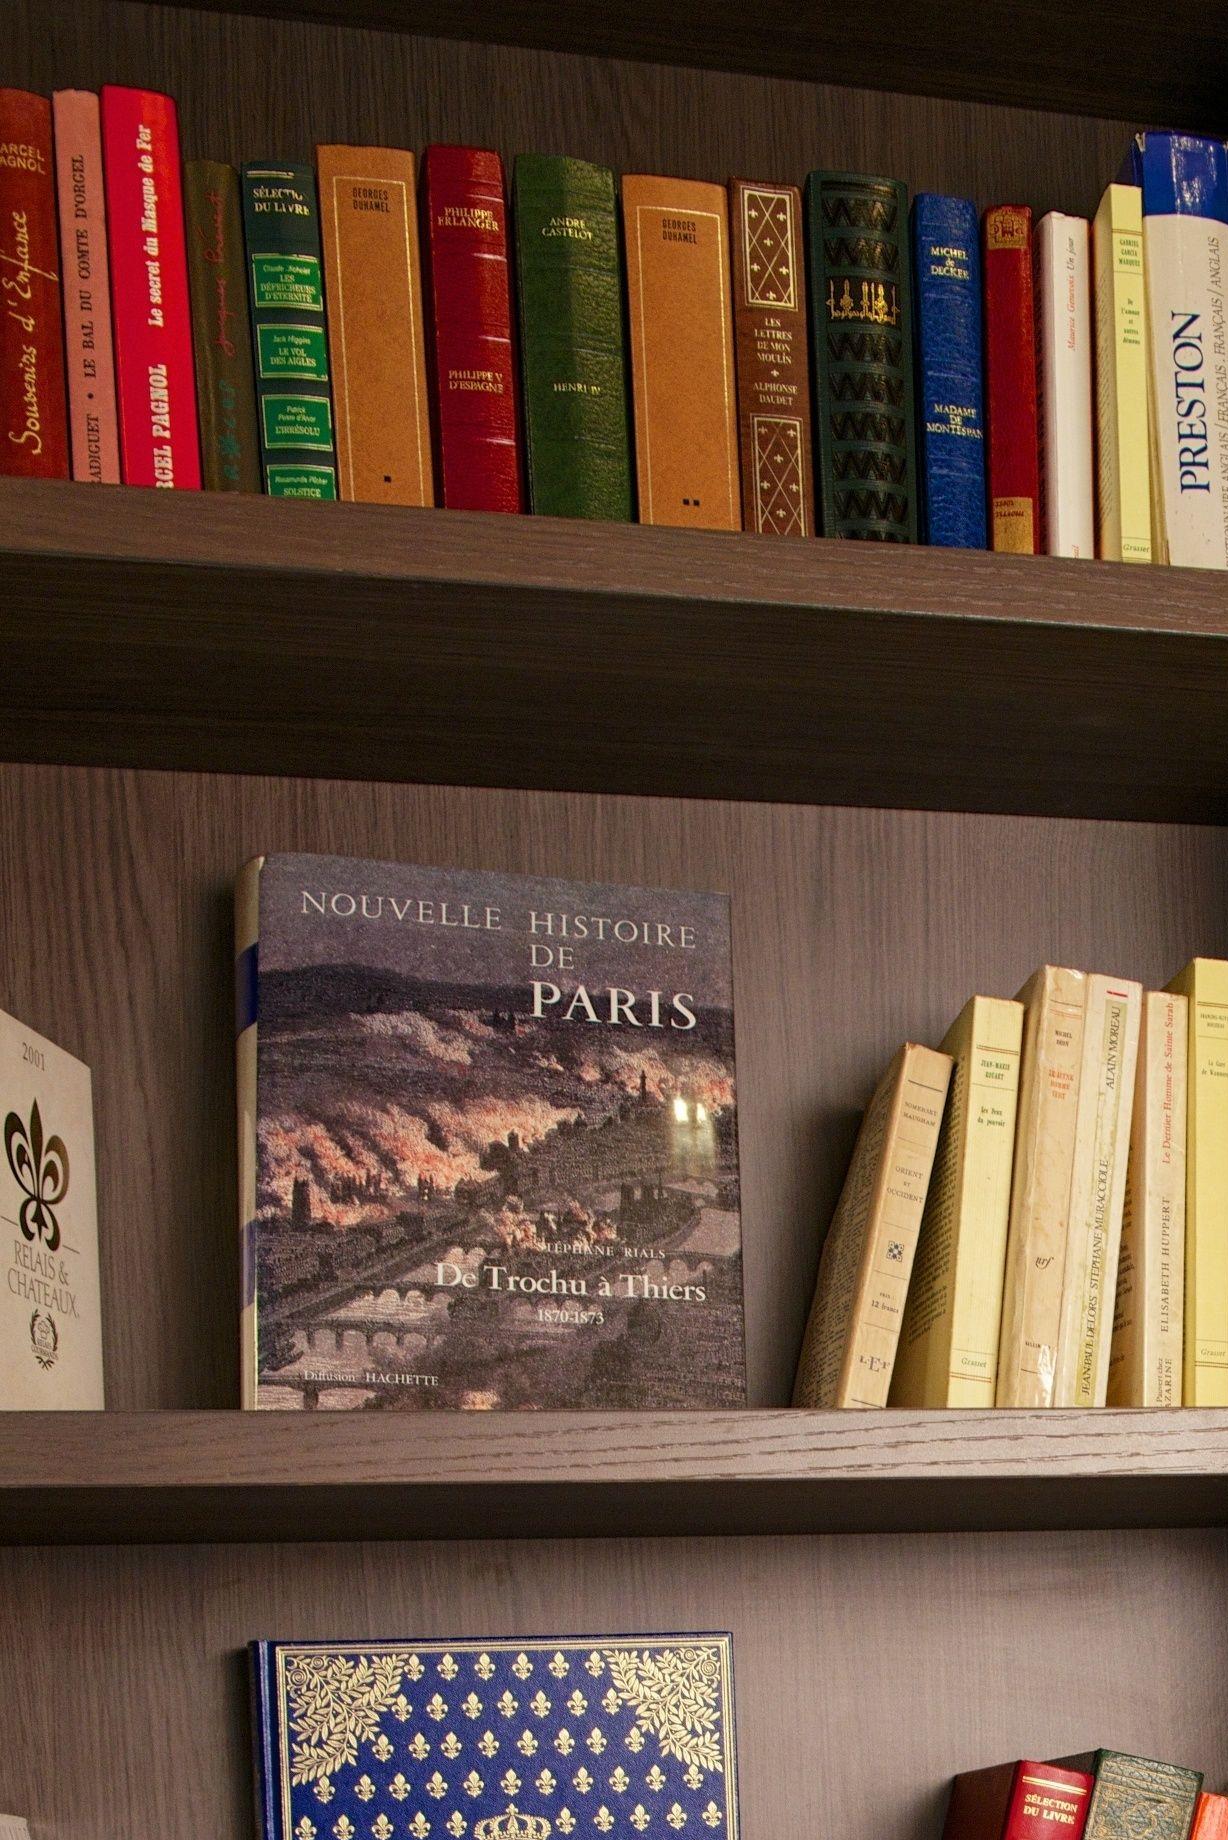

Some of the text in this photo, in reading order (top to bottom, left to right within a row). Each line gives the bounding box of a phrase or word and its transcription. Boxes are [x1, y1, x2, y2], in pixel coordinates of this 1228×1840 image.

[444, 206, 494, 221] PHILIPPE
[437, 215, 500, 232] ERLANGER
[661, 218, 697, 233] GEORGES
[661, 230, 699, 245] DUHAMEL
[930, 246, 969, 261] MICHEL
[135, 123, 175, 489] RCEL PAGNOL Le secret du Masque de Fer
[71, 154, 103, 484] ADIGUET LE BAL DU COMTE D'ORGEL
[764, 317, 781, 328] LES
[754, 328, 793, 341] LETTRES
[757, 341, 791, 353] DE MON
[752, 382, 799, 396] ALPHONSE
[8, 344, 43, 456] Souvenirs
[758, 393, 794, 407] DAUDET
[1170, 309, 1212, 496] PRESTON
[933, 403, 977, 419] MADAME
[949, 415, 963, 426] DE
[926, 421, 984, 439] MONTESPAN
[1122, 542, 1151, 554] Grasset
[299, 890, 698, 950] NOUVELLE HISTOIRE
[529, 943, 576, 970] DE
[529, 980, 699, 1031] PARIS
[1104, 1005, 1122, 1091] ALAIN MOREAU
[20, 1041, 46, 1073] 2001
[894, 1165, 924, 1181] ORIENT
[623, 1243, 667, 1260] RIALS
[14, 1239, 69, 1287] RELAIS &
[1160, 1196, 1172, 1334] ELISABETH HUPPERT
[435, 1261, 708, 1303] De Trochu à Thiers
[537, 1308, 605, 1326] 1870-1873
[1200, 1347, 1227, 1359] Grasset
[960, 1356, 988, 1370] Grasset
[303, 1369, 440, 1388] Diffusion HACHETTE
[1024, 1792, 1079, 1815] SÉLECTION
[1023, 1805, 1076, 1826] DU LIVRE
